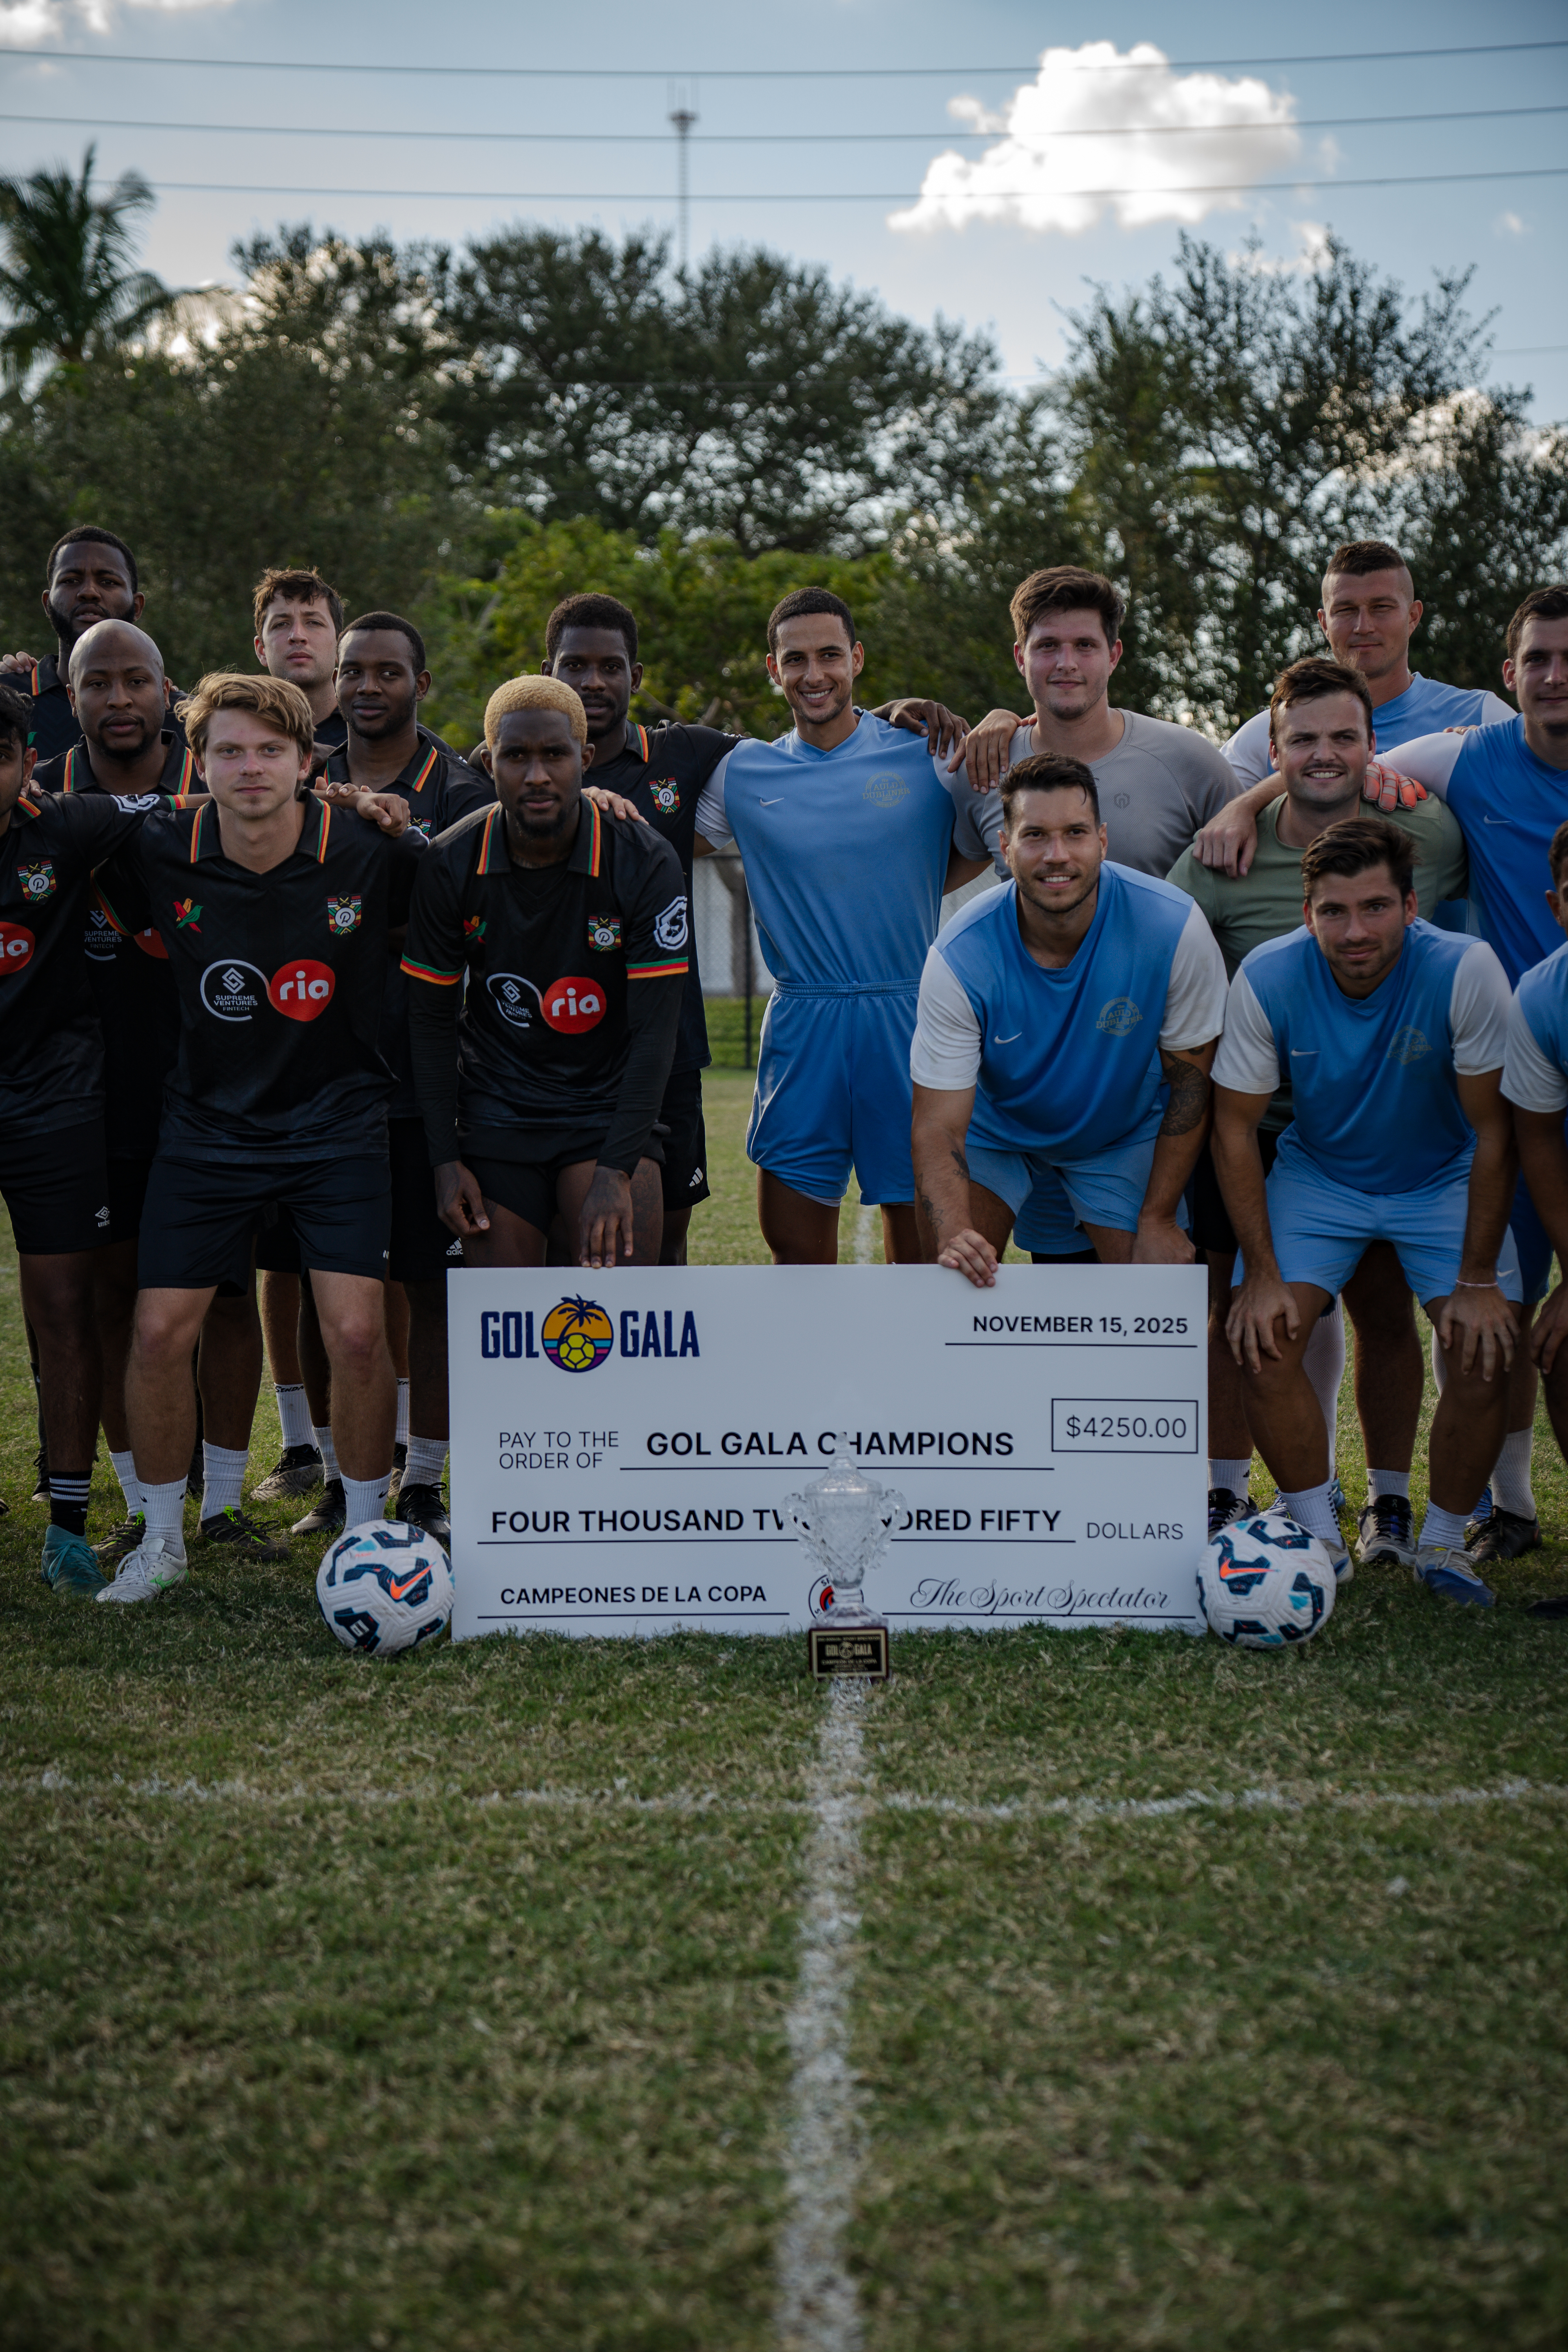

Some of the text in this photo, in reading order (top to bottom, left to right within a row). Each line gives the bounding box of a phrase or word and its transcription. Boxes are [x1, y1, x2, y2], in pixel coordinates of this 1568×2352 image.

[862, 788, 910, 799] DUBLINER
[873, 782, 898, 791] AULD
[0, 933, 28, 958] ia
[280, 971, 329, 1000] ria
[552, 987, 600, 1016] ria
[481, 1310, 700, 1358] GOL GALA
[974, 1316, 1188, 1336] NOVEMBER 15, 2025
[1067, 1415, 1186, 1439] $4250.00
[500, 1431, 618, 1448] PAY TO THE
[647, 1432, 711, 1456] GOL
[721, 1432, 808, 1455] GALA
[499, 1452, 603, 1469] ORDER OF
[492, 1511, 570, 1533] FOUR
[578, 1509, 744, 1532] THOUSAND
[981, 1510, 1061, 1532] FIFTY
[1087, 1523, 1183, 1540] DOLLARS
[501, 1586, 767, 1604] CAMPEONES DE LA COPA
[910, 1578, 1171, 1616] The Sport Spectator
